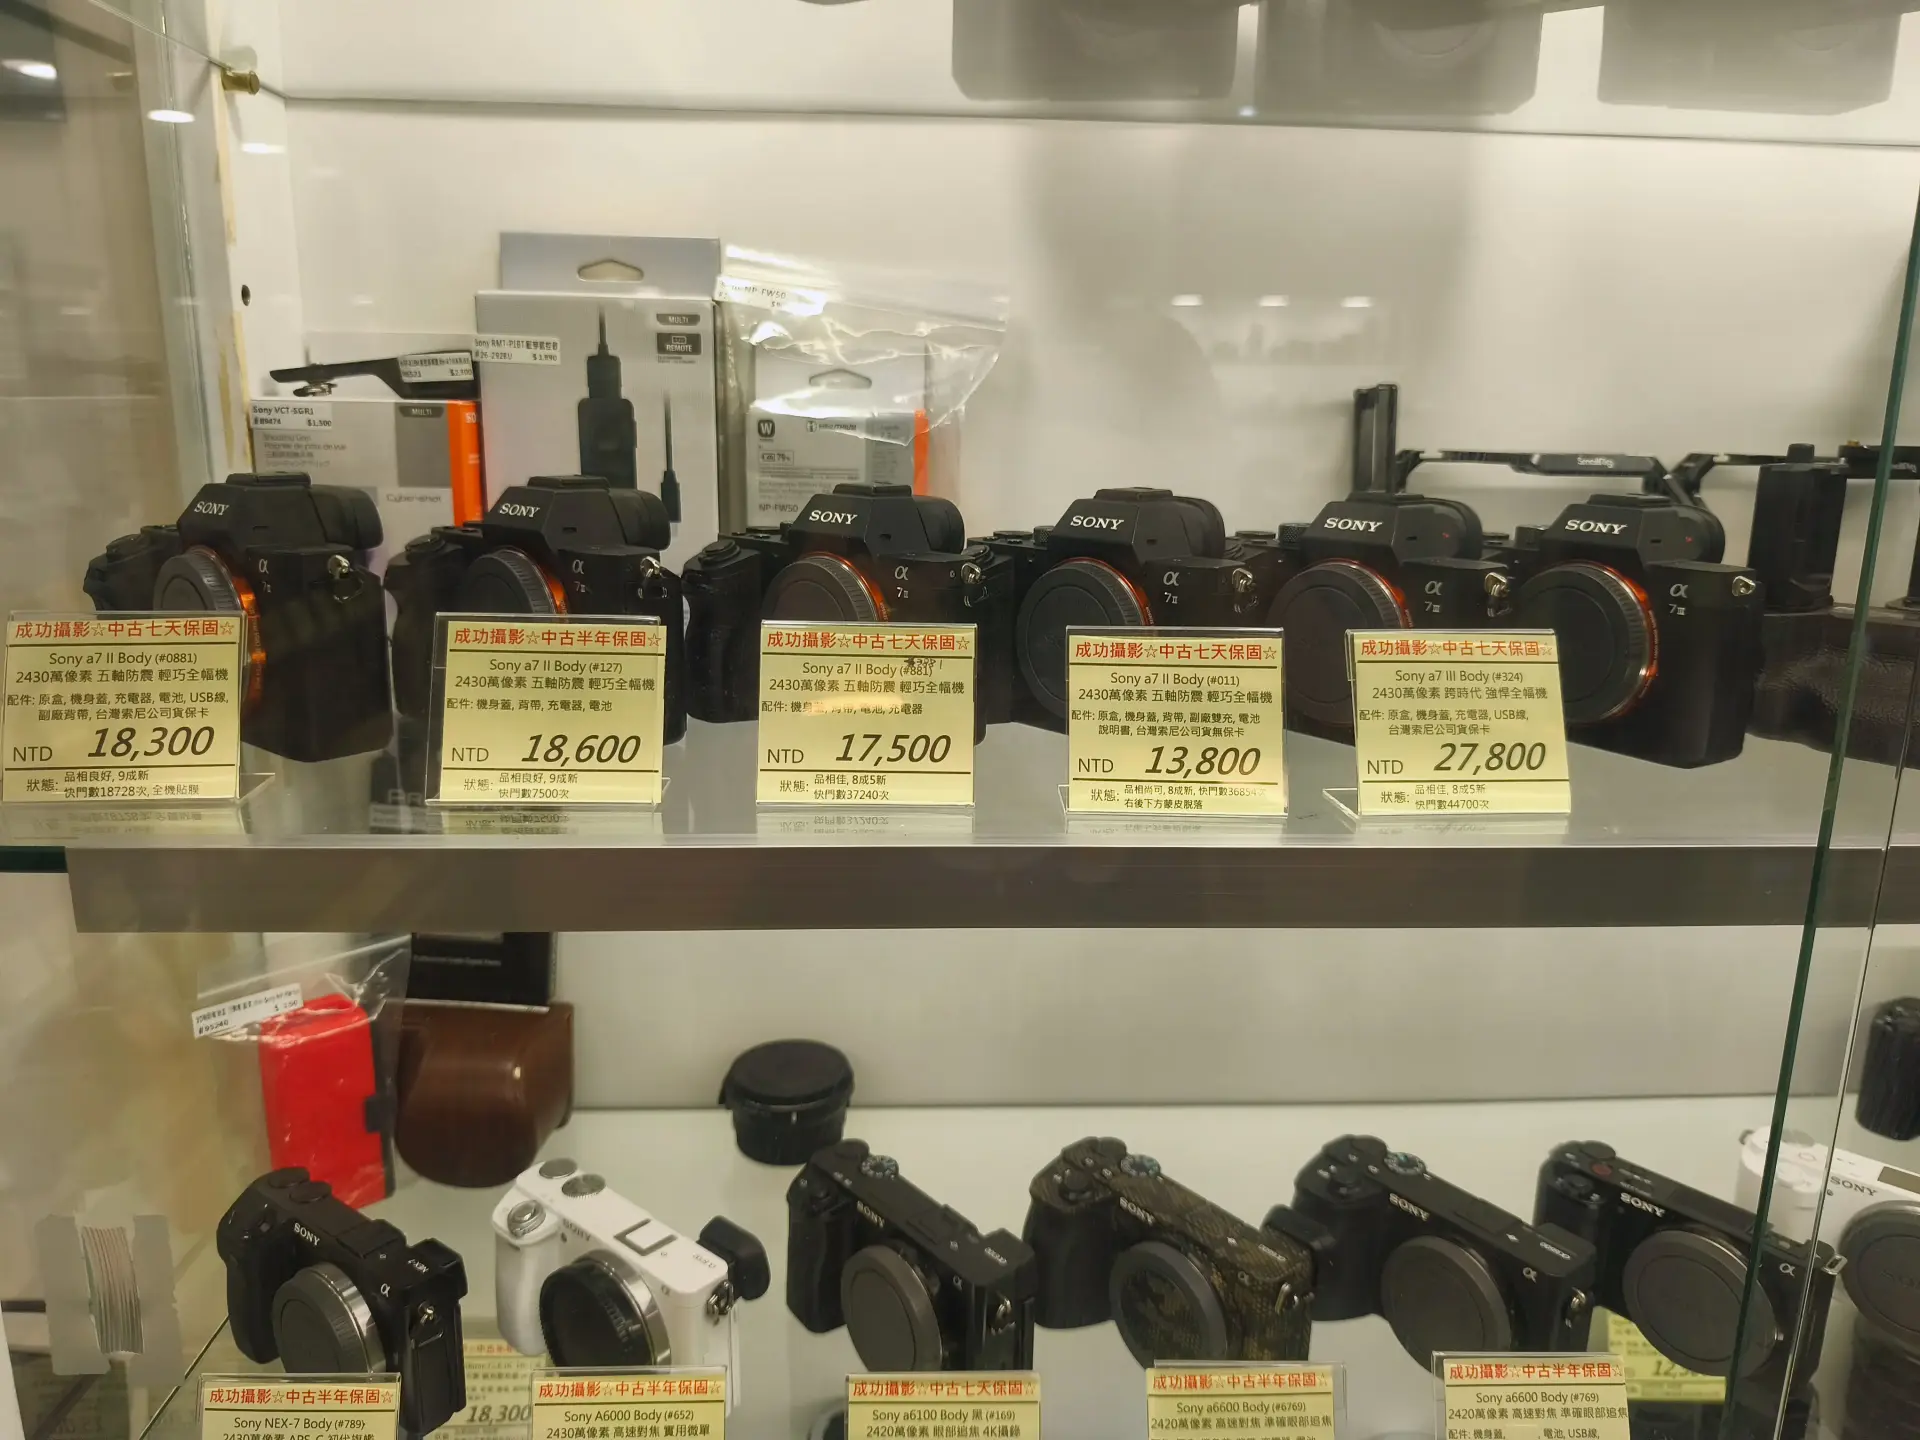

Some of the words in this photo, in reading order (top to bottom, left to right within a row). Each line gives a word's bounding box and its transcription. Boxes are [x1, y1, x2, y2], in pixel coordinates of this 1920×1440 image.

[666, 344, 692, 352] REMOTE
[253, 406, 273, 417] Sony
[411, 408, 432, 416] MULTI
[194, 501, 230, 516] SONY
[499, 503, 540, 518] SONY
[809, 509, 858, 525] SONY
[1070, 515, 1124, 530] SONY
[1324, 517, 1383, 533] SONY
[1565, 519, 1628, 535] SONY
[49, 653, 83, 667] Sony
[86, 653, 103, 664] a7
[118, 652, 152, 666] Body
[155, 653, 198, 666] (#0881)
[489, 660, 521, 672] Sony
[524, 660, 539, 671] a7
[555, 661, 587, 675] Body
[589, 662, 622, 674] (#127)
[803, 663, 833, 676] Sony
[837, 663, 851, 674] a7
[866, 664, 897, 678] Body
[16, 670, 93, 683] 2430萬像素
[97, 669, 153, 682] 五軸防震
[158, 668, 228, 681] 輕巧全幅機
[1110, 673, 1141, 685] Sony
[1144, 674, 1158, 684] a7
[1173, 674, 1204, 687] Body
[1207, 675, 1240, 687] (#011)
[1395, 670, 1425, 684] Sony
[1428, 670, 1442, 682] a7
[1460, 670, 1490, 684] Body
[1492, 671, 1523, 683] (#324)
[455, 676, 527, 689] 2430萬像素
[532, 677, 584, 690] 五軸防震
[589, 677, 655, 691] 輕巧全幅機
[769, 679, 840, 692] 2430萬像素
[844, 679, 895, 693] 五軸防震
[900, 681, 965, 695] 輕巧全幅機
[1078, 689, 1148, 702] 2430萬像素
[1151, 690, 1203, 703] 五軸防震
[1207, 690, 1272, 704] 輕巧全幅機
[1372, 686, 1441, 700] 2430萬像素
[1444, 687, 1482, 699] 跨時代
[1485, 687, 1548, 700] 強悍全幅機
[589, 700, 612, 712] 電池
[1239, 713, 1260, 724] 電池
[87, 726, 215, 762] 18,300
[521, 734, 641, 767] 18,600
[835, 733, 951, 766] 17,500
[12, 747, 53, 762] NTD
[452, 748, 489, 762] NTD
[767, 749, 804, 764] NTD
[1433, 742, 1546, 775] 27,800
[1078, 758, 1114, 773] NTD
[1145, 746, 1261, 779] 13,800
[1367, 760, 1404, 775] NTD
[118, 770, 149, 781] 9成新
[550, 774, 578, 784] 9成新
[852, 774, 887, 785] 8成5新
[499, 788, 569, 799] 快門數7500次
[814, 789, 889, 800] 快門數37240次
[1452, 784, 1486, 795] 8成5新
[1415, 799, 1490, 810] 快門數44700次
[1830, 1176, 1877, 1196] SONY
[1119, 1197, 1155, 1226] SONY
[1389, 1193, 1430, 1222] SONY
[1620, 1192, 1665, 1218] SONY
[857, 1200, 885, 1228] SONY
[294, 1222, 320, 1247] SONY
[562, 1217, 591, 1242] SONY
[1476, 1392, 1502, 1405] Sony
[1506, 1391, 1538, 1403] a6600
[1541, 1391, 1570, 1404] Body
[1570, 1392, 1600, 1404] (#769)
[872, 1409, 900, 1423] Sony
[903, 1408, 937, 1421] a6100
[940, 1408, 969, 1422] Body
[1177, 1401, 1203, 1415] Sony
[1206, 1401, 1239, 1413] a6600
[1242, 1401, 1270, 1414] Body
[1448, 1406, 1508, 1420] 2420萬像素
[234, 1417, 260, 1430] Sony
[265, 1417, 300, 1429] NEX-7
[303, 1417, 332, 1431] Body
[565, 1410, 592, 1424] Sony
[595, 1410, 630, 1422] A6000
[634, 1409, 662, 1423] Body
[664, 1410, 694, 1422] (#652)
[547, 1425, 609, 1439] 2430萬像素
